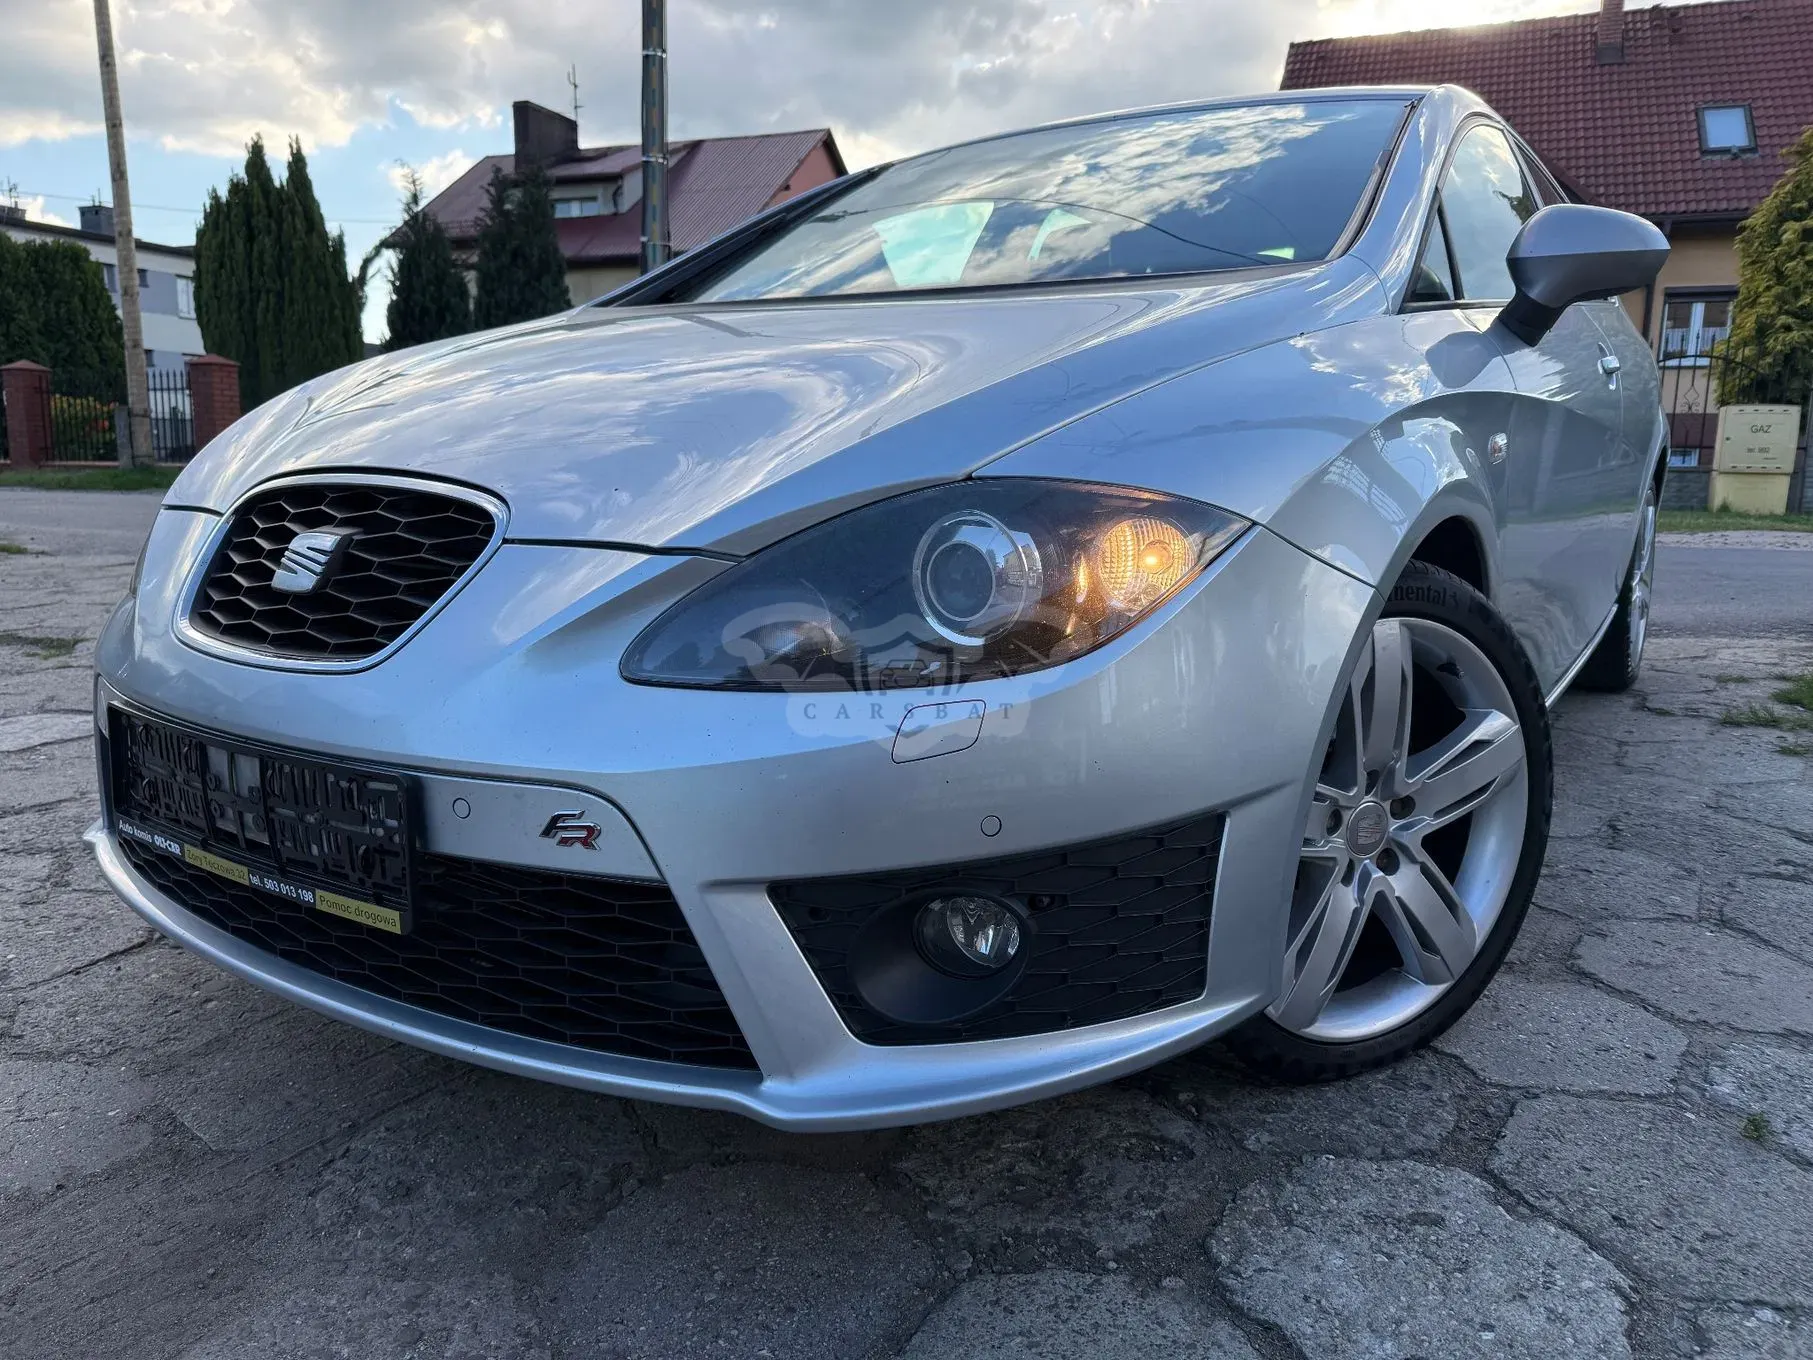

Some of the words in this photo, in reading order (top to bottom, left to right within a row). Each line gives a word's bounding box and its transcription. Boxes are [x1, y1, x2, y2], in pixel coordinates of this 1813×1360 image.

[1750, 424, 1772, 434] GAZ
[1389, 584, 1447, 607] nental
[539, 809, 601, 850] FR
[119, 819, 133, 835] Auto
[133, 826, 152, 843] komis
[250, 873, 263, 887] tel.
[264, 878, 279, 892] 503
[280, 883, 296, 898] 013
[298, 888, 314, 903] 198
[319, 895, 352, 914] Pomoc
[354, 906, 397, 925] drogowa
